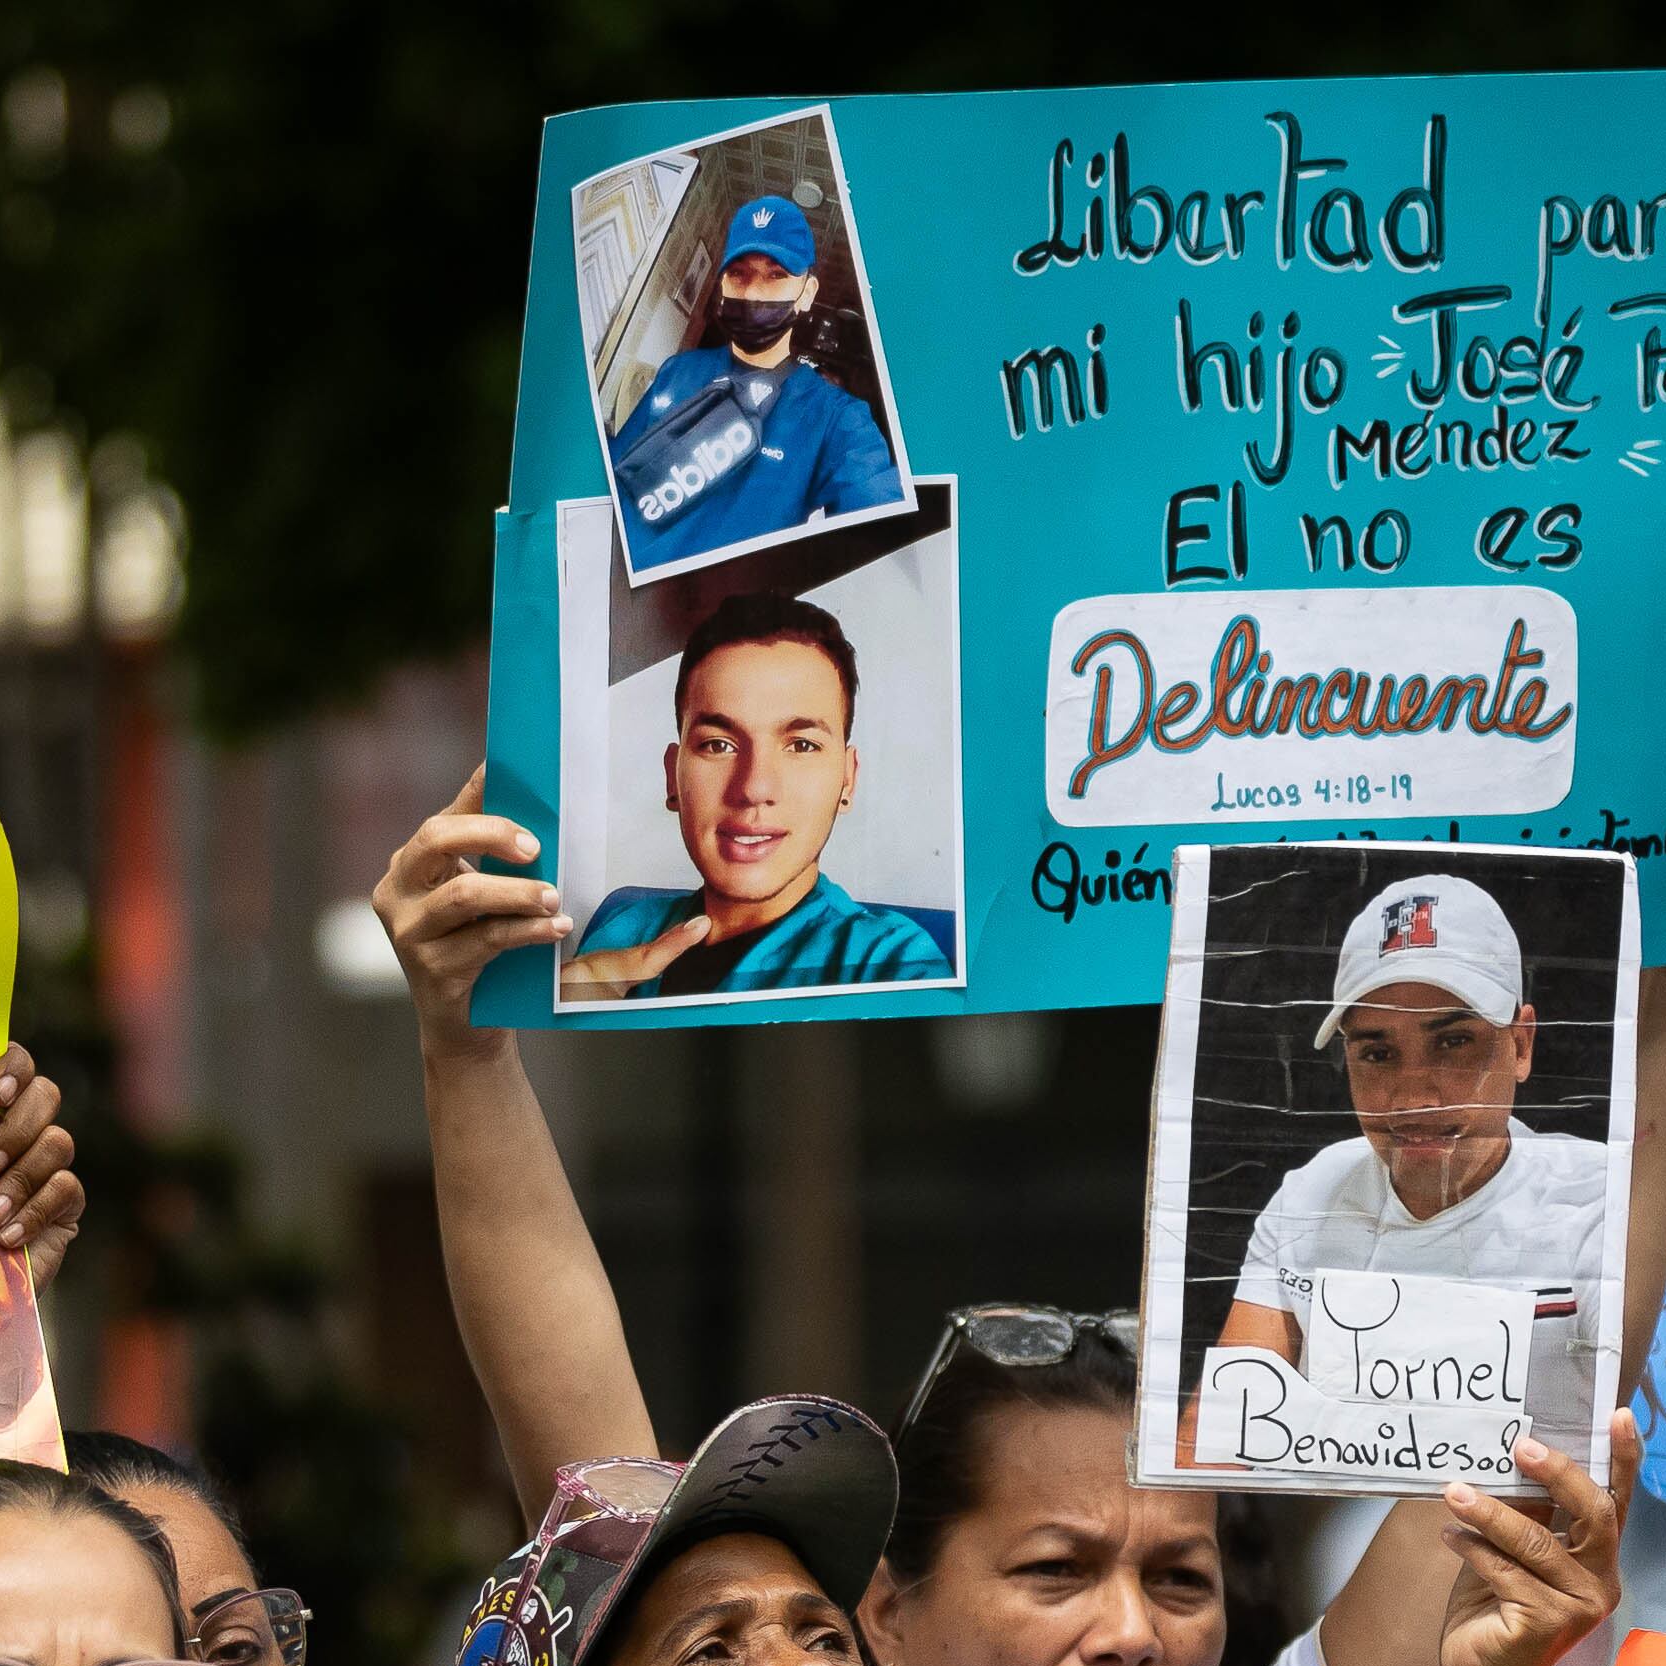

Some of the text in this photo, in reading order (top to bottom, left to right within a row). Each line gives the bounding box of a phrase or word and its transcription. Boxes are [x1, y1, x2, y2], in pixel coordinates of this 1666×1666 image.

[1012, 110, 1447, 277] Libertad
[998, 323, 1110, 441] mi
[1174, 298, 1348, 488] hijo
[1392, 285, 1601, 412] José
[1329, 410, 1592, 490] Méndez
[1162, 480, 1584, 587] El no es
[1067, 611, 1574, 800] Delincuente
[1210, 771, 1414, 812] Lucas 4:18-19
[1031, 840, 1175, 925] Quién
